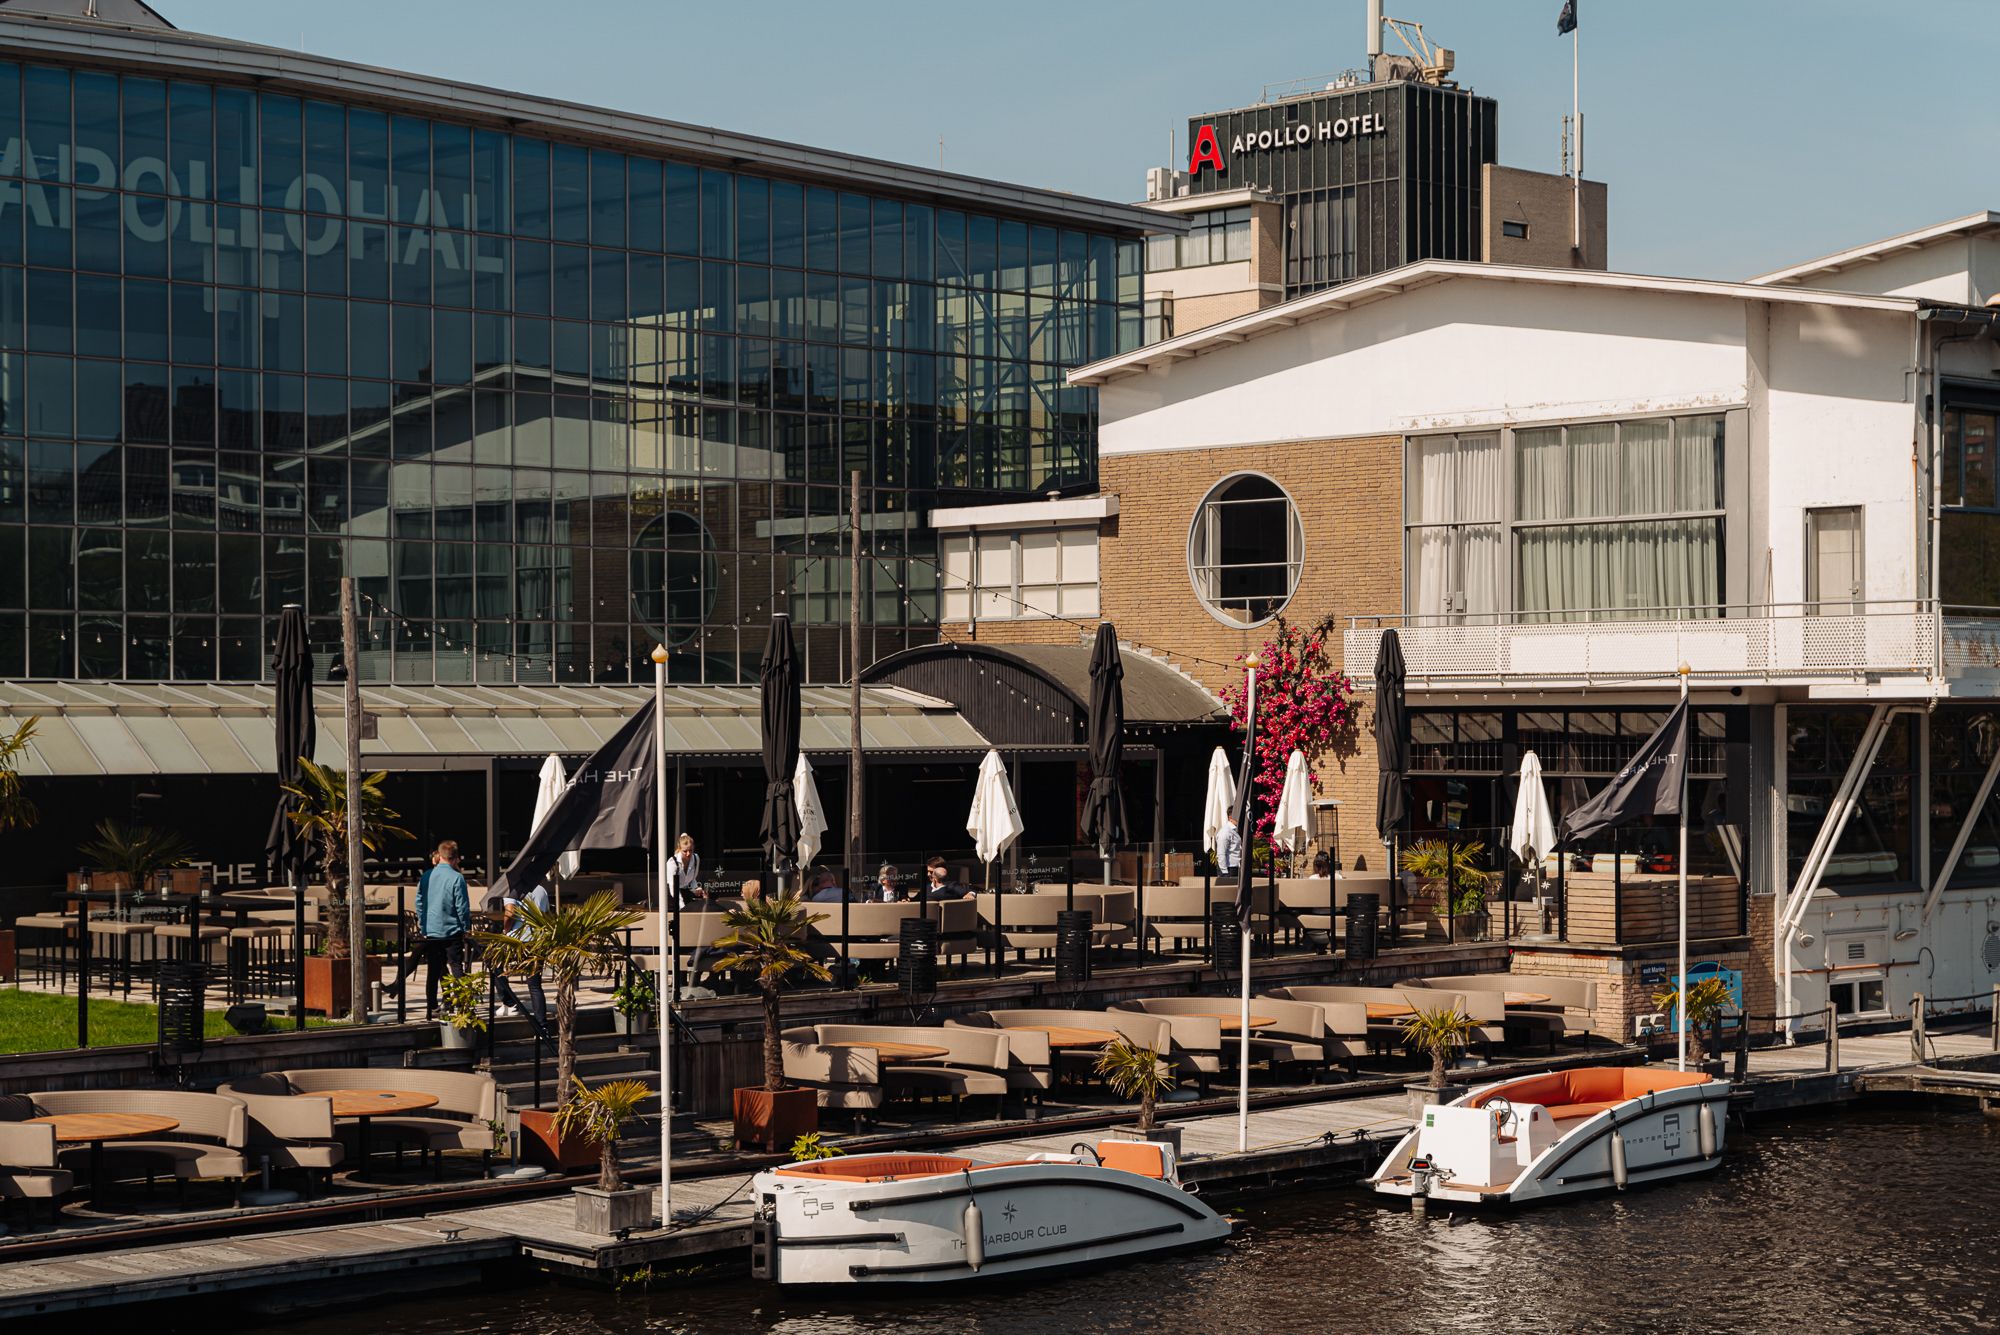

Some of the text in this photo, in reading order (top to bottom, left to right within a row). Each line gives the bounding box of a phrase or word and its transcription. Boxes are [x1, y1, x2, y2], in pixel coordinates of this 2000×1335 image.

[1231, 124, 1311, 154] APOLLO
[1318, 112, 1385, 141] HOTEL
[0, 136, 504, 274] APOLLOHAL
[188, 860, 257, 885] THE
[951, 1239, 967, 1250] TH
[1037, 1224, 1067, 1237] CLUB
